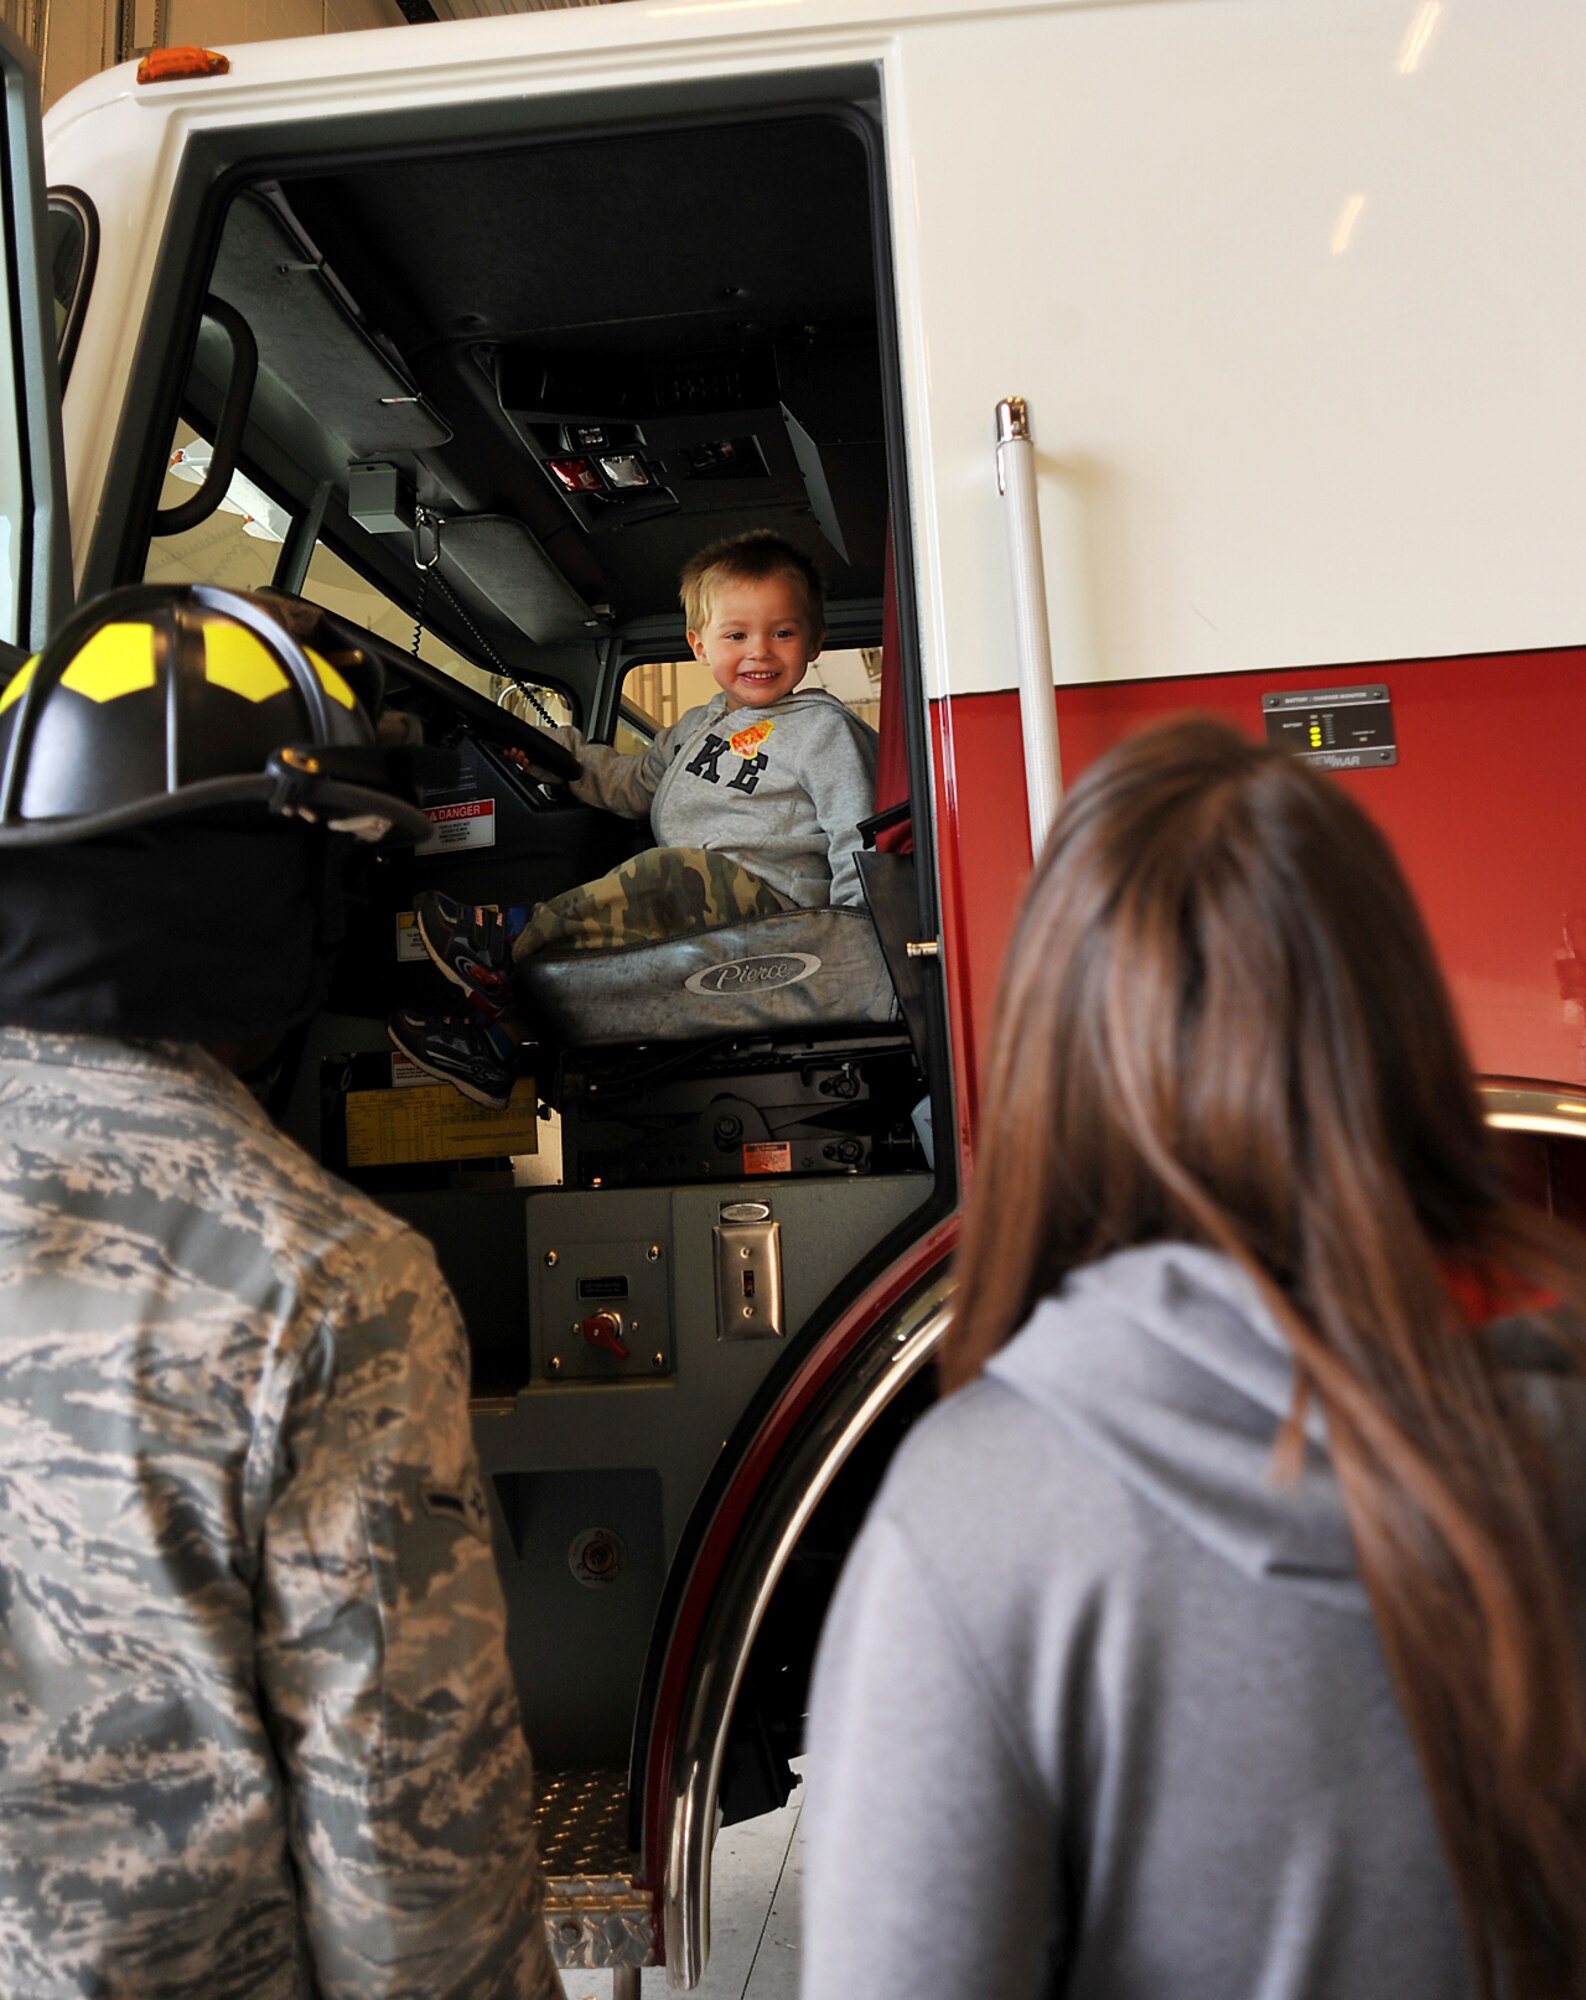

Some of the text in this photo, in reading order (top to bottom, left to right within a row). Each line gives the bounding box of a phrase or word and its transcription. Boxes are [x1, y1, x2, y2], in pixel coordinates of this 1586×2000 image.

[674, 733, 768, 794] KE
[438, 804, 481, 820] DANGER
[716, 963, 788, 990] Pierce
